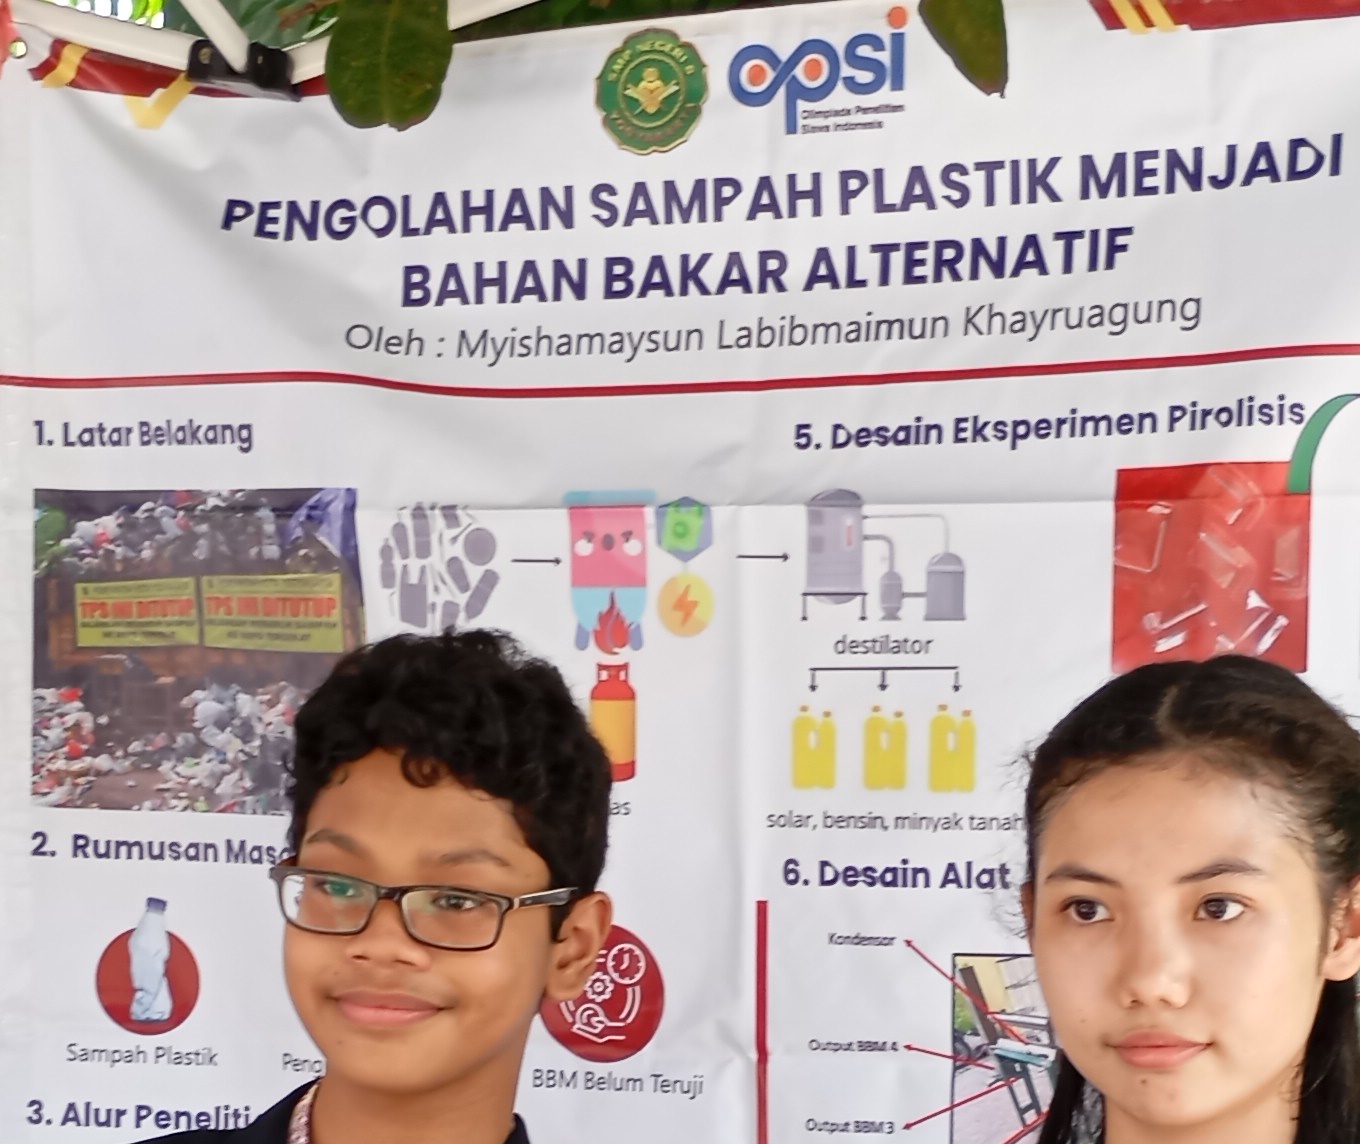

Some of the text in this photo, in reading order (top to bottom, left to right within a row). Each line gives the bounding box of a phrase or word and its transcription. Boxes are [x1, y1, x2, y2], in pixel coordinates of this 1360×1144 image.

[220, 133, 1345, 242] PENGOLAHAN SAMPAH PLASTIK MENJADI
[400, 226, 1135, 308] BAHAN BAKAR ALTERNATIF
[344, 323, 424, 358] Oleh
[456, 325, 704, 367] Myishamaysun
[717, 311, 950, 350] Labibmaimun
[962, 291, 1202, 343] Khayruagung
[33, 420, 254, 453] 1. Latar Belakang
[792, 392, 1307, 452] 5. Desain Eksperimen Pirolisis
[834, 634, 934, 656] destilator
[766, 810, 818, 831] solar,
[823, 812, 889, 832] bensin,
[894, 814, 963, 833] minyak
[31, 832, 291, 866] 2. Rumusan Masa
[783, 858, 1011, 890] 6. Desain Alat
[828, 933, 896, 946] Kondensor
[66, 1043, 218, 1067] Sampah Plastik
[808, 1039, 855, 1053] Output
[858, 1041, 888, 1052] BBM
[532, 1069, 704, 1099] BBM Belum Teruji
[27, 1100, 250, 1130] 3. Alur Peneliti
[805, 1118, 851, 1134] Output
[854, 1121, 884, 1134] BBM
